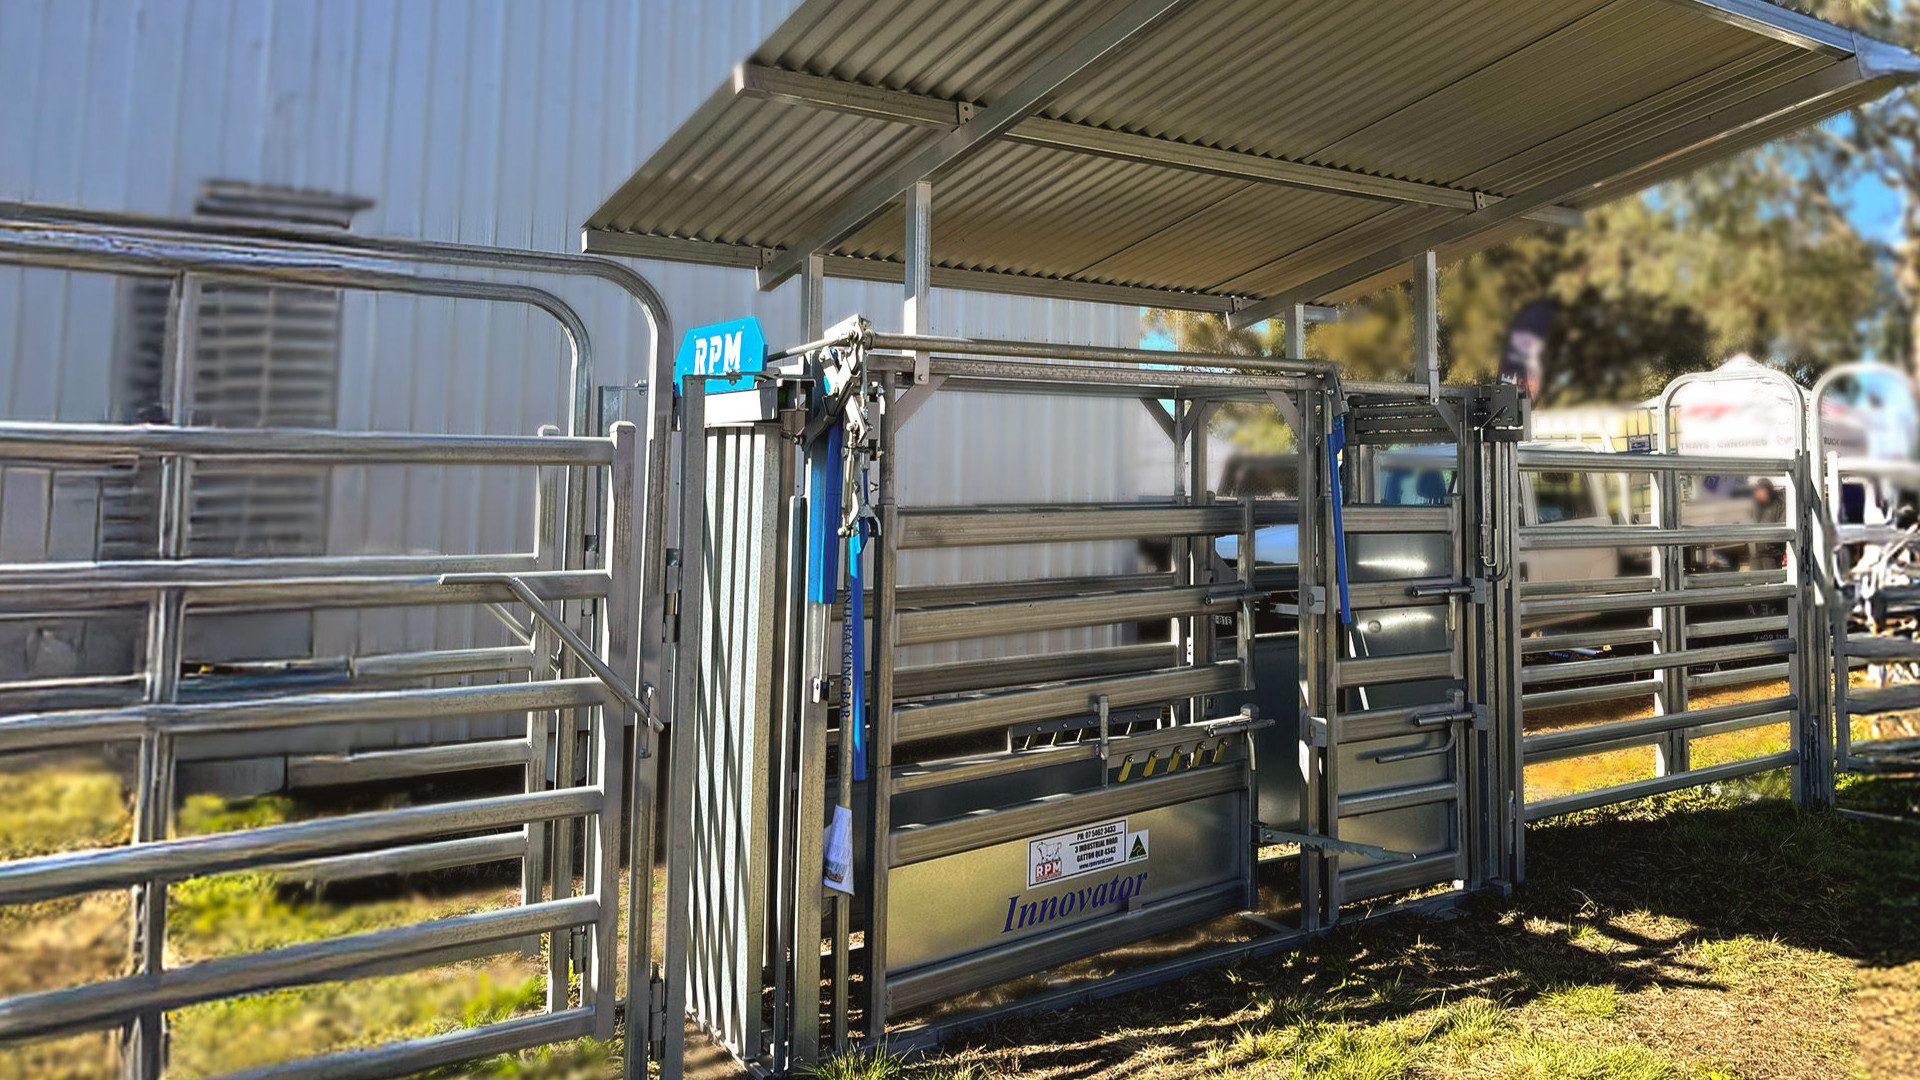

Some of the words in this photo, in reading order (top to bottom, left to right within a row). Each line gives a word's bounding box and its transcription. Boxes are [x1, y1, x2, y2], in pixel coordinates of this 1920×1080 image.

[694, 331, 743, 375] RPM
[840, 692, 851, 719] BAR
[1079, 840, 1105, 852] INDUSTRIAL
[1105, 837, 1118, 846] ROAD
[1077, 851, 1095, 862] GATTON
[1095, 850, 1103, 859] QLD
[1036, 861, 1061, 877] RPM
[1001, 872, 1148, 933] Innovator
